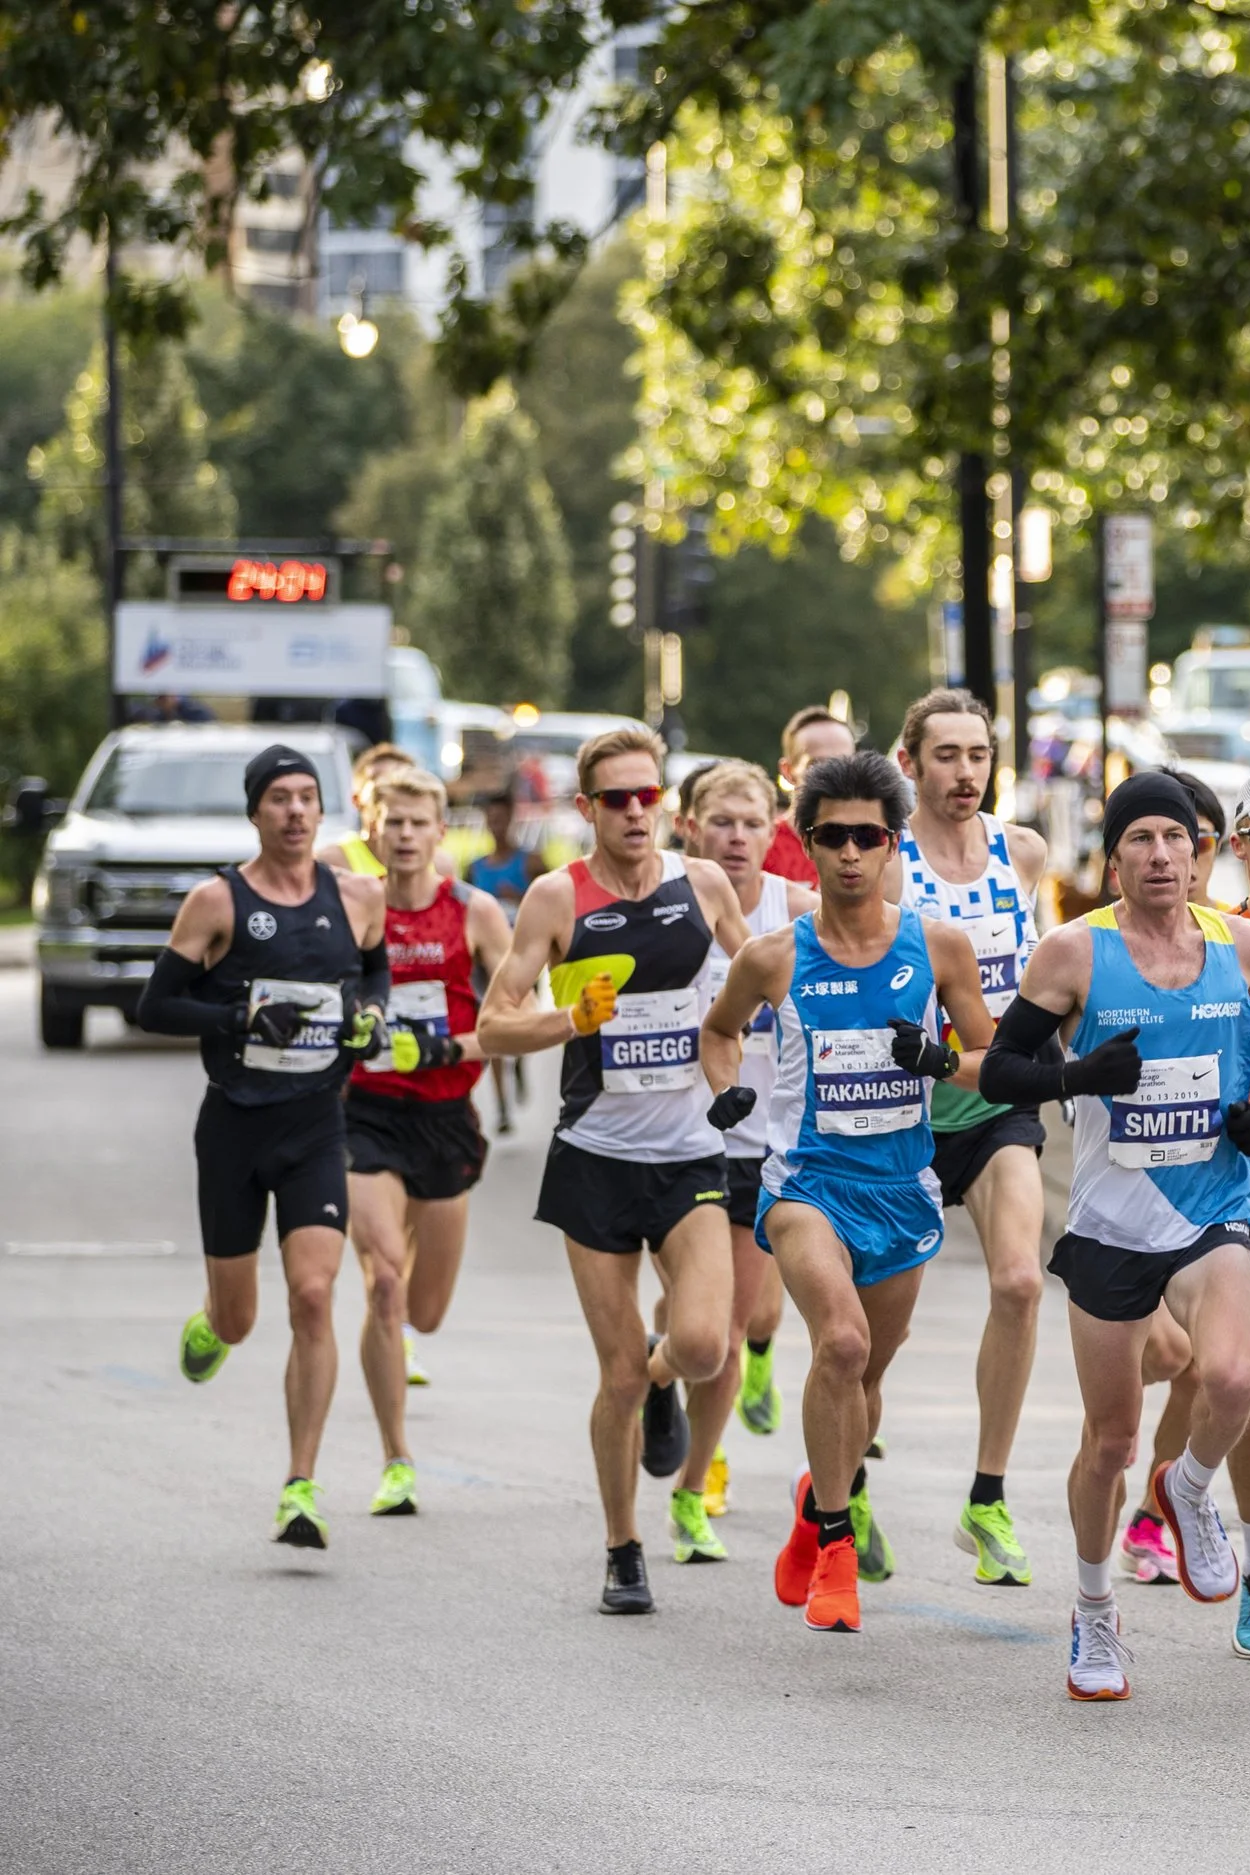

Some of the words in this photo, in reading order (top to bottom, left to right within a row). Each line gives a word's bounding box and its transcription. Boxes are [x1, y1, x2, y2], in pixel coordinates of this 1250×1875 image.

[652, 903, 689, 917] BROOKS
[979, 963, 1006, 989] CK
[800, 980, 859, 997] 大塚製薬
[1097, 1008, 1150, 1018] NORTHERN
[1191, 1003, 1229, 1020] HOKA
[1098, 1016, 1137, 1026] ARIZONA
[1140, 1015, 1165, 1024] ELITE
[613, 1036, 692, 1065] GREGG
[817, 1079, 920, 1102] TAKAHASHI
[1140, 1091, 1199, 1102] 10.13.2019
[1124, 1109, 1209, 1137] SMITH
